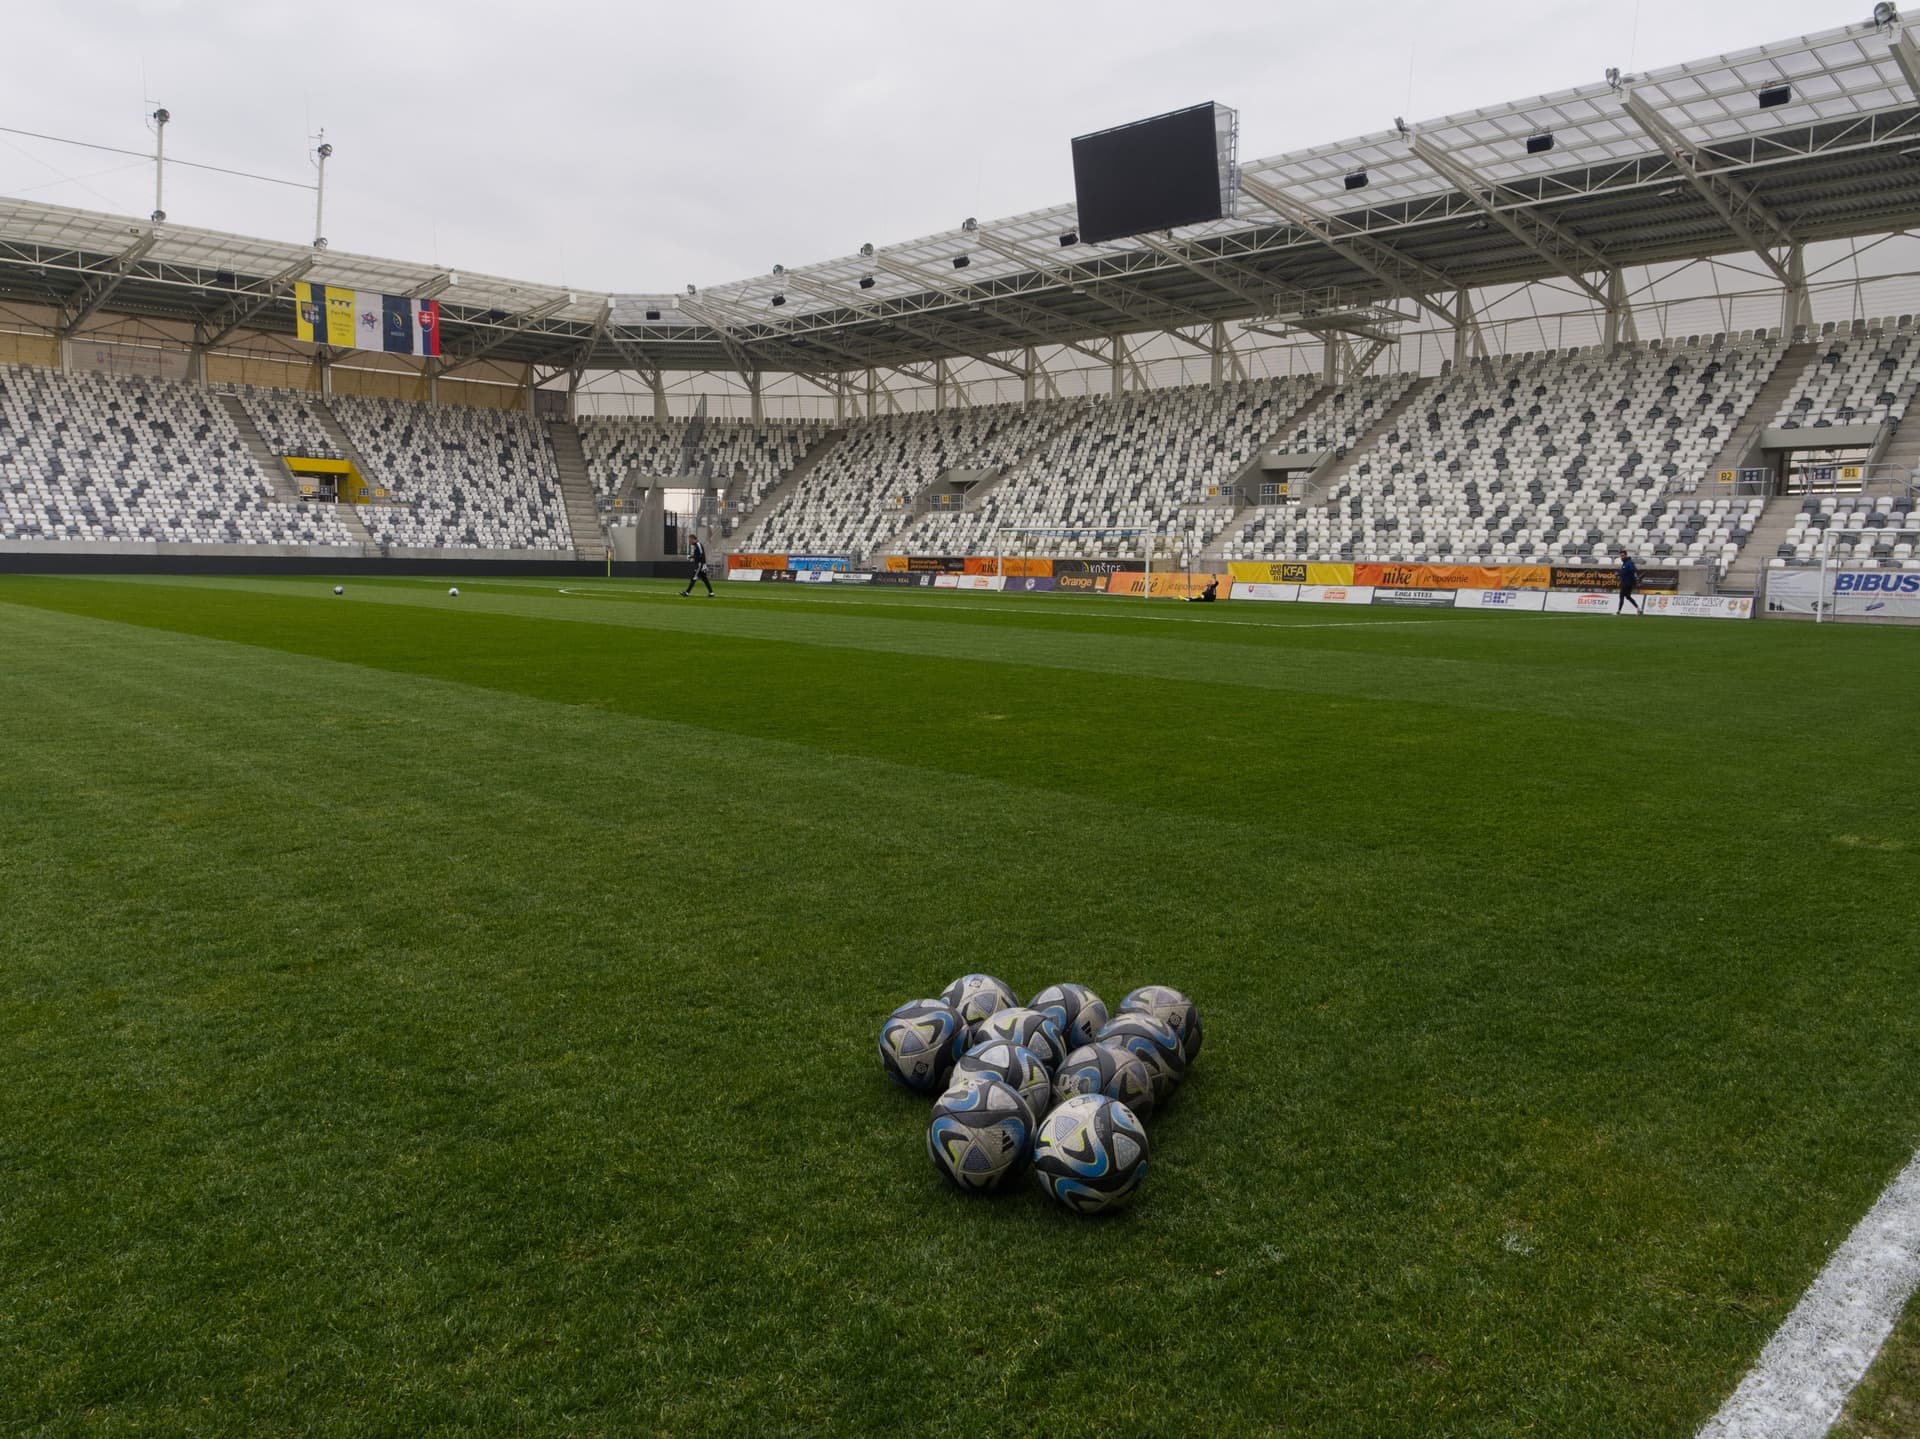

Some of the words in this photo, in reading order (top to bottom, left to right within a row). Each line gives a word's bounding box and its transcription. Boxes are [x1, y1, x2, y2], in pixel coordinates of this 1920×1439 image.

[1721, 471, 1733, 482] B2
[1844, 467, 1857, 478] B1
[1283, 565, 1305, 577] KFA
[1382, 567, 1413, 585] niké
[1060, 575, 1092, 589] Orange
[1834, 573, 1920, 593] BIBUS
